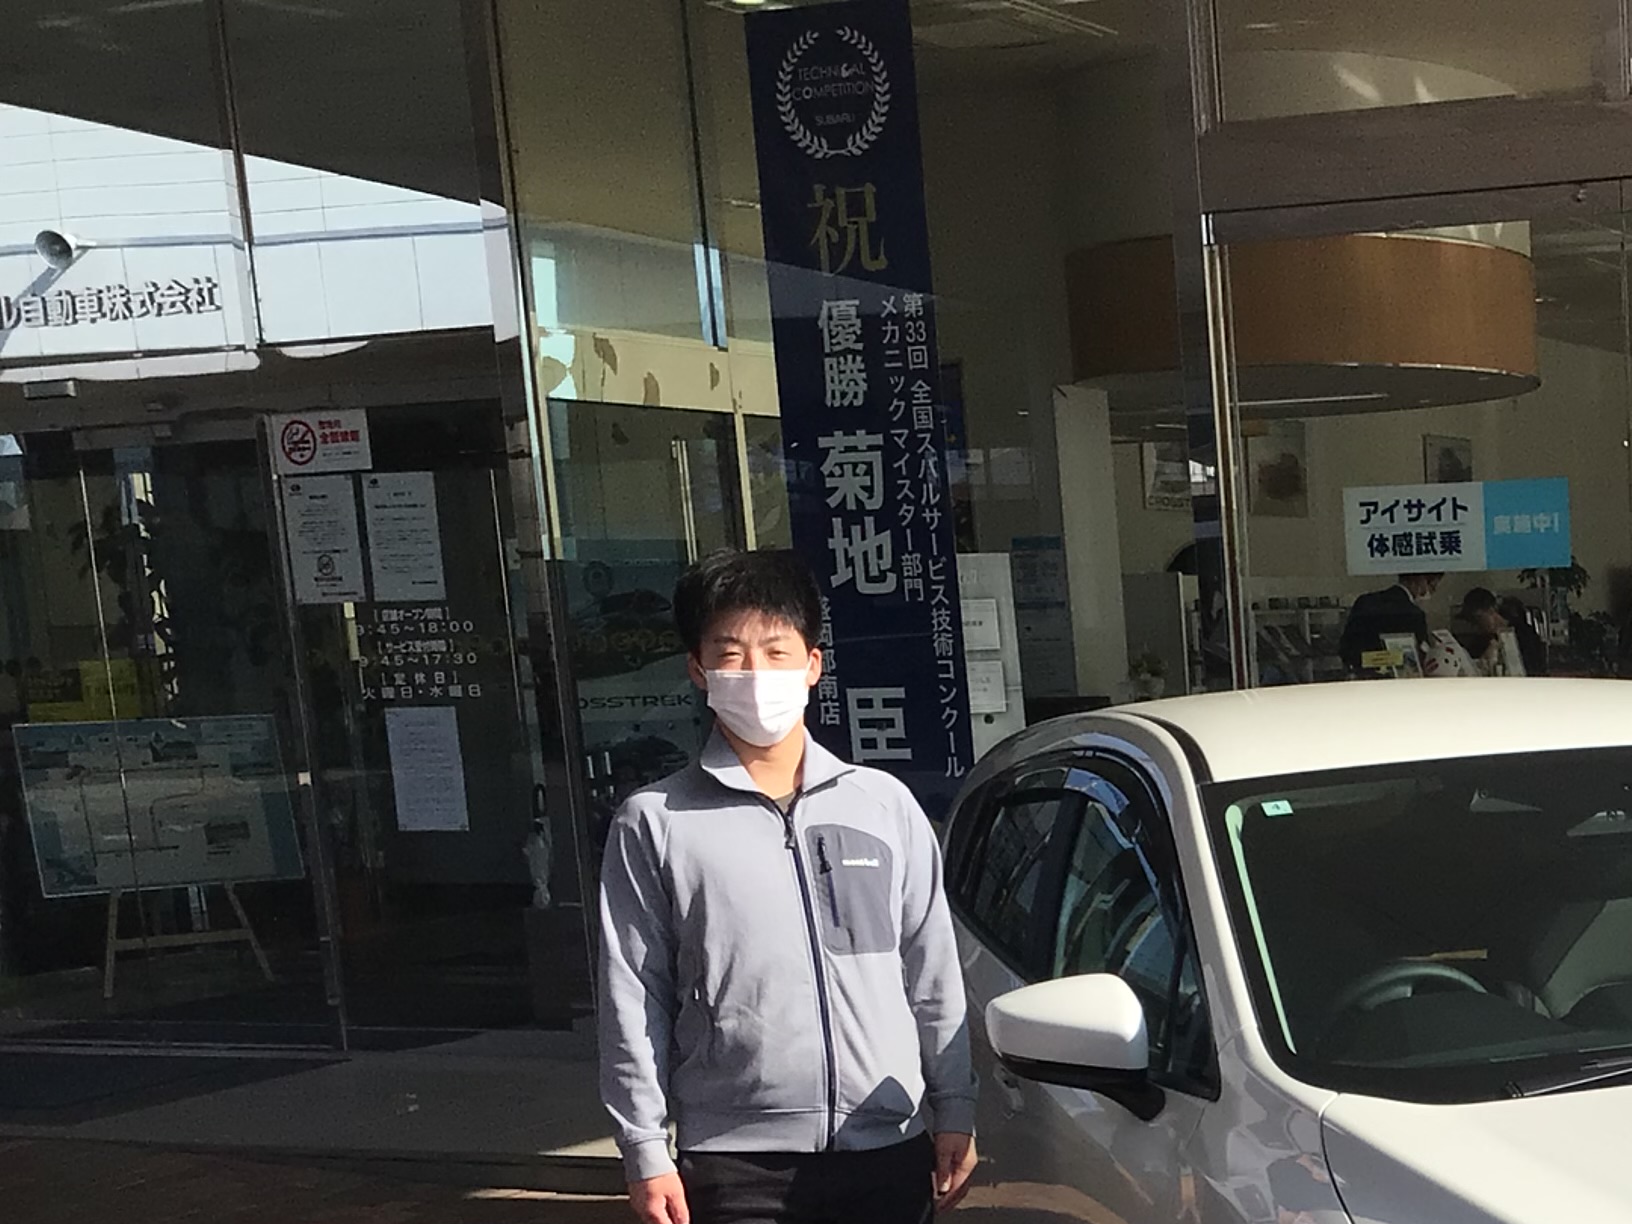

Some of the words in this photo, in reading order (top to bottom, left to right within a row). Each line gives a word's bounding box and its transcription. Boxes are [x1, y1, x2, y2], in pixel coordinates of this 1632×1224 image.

[806, 182, 888, 278] 祝
[818, 300, 868, 407] 優勝
[902, 292, 930, 370] 第33回
[818, 430, 897, 595] 菊地
[1358, 496, 1469, 526] アイサイト
[1367, 530, 1463, 559] 体感試乗
[845, 687, 913, 763] 臣
